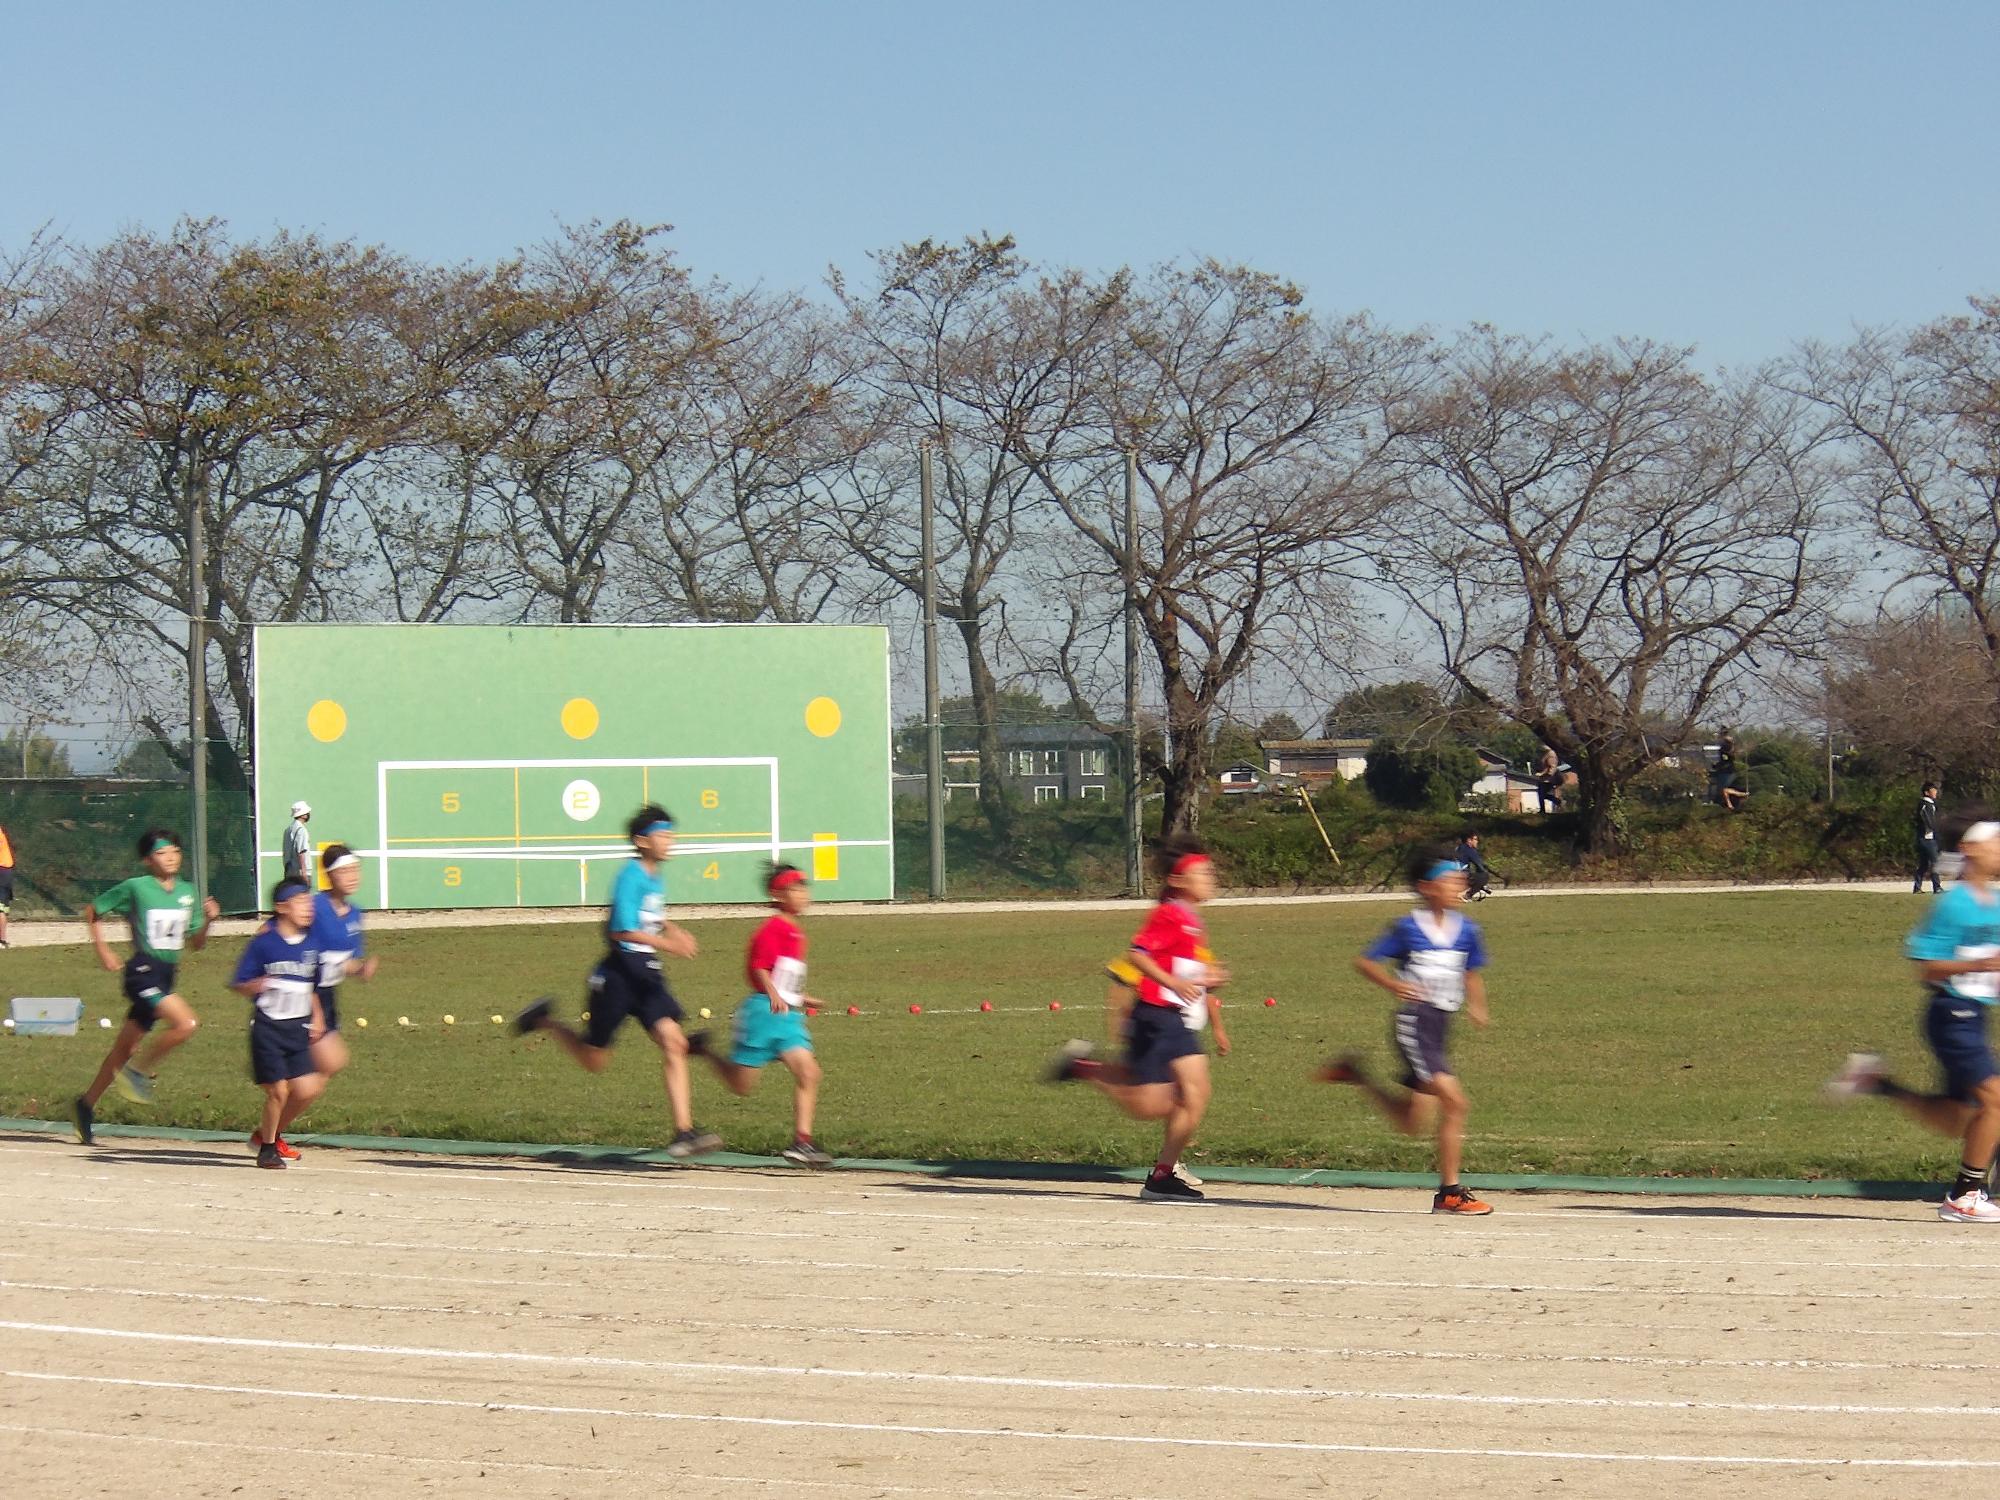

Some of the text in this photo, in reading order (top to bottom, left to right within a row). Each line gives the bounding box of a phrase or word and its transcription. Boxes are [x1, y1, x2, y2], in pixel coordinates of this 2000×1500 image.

[442, 792, 460, 813] 5
[572, 791, 589, 809] 2
[702, 789, 720, 809] 6
[444, 866, 462, 886] 3
[703, 862, 720, 880] 4
